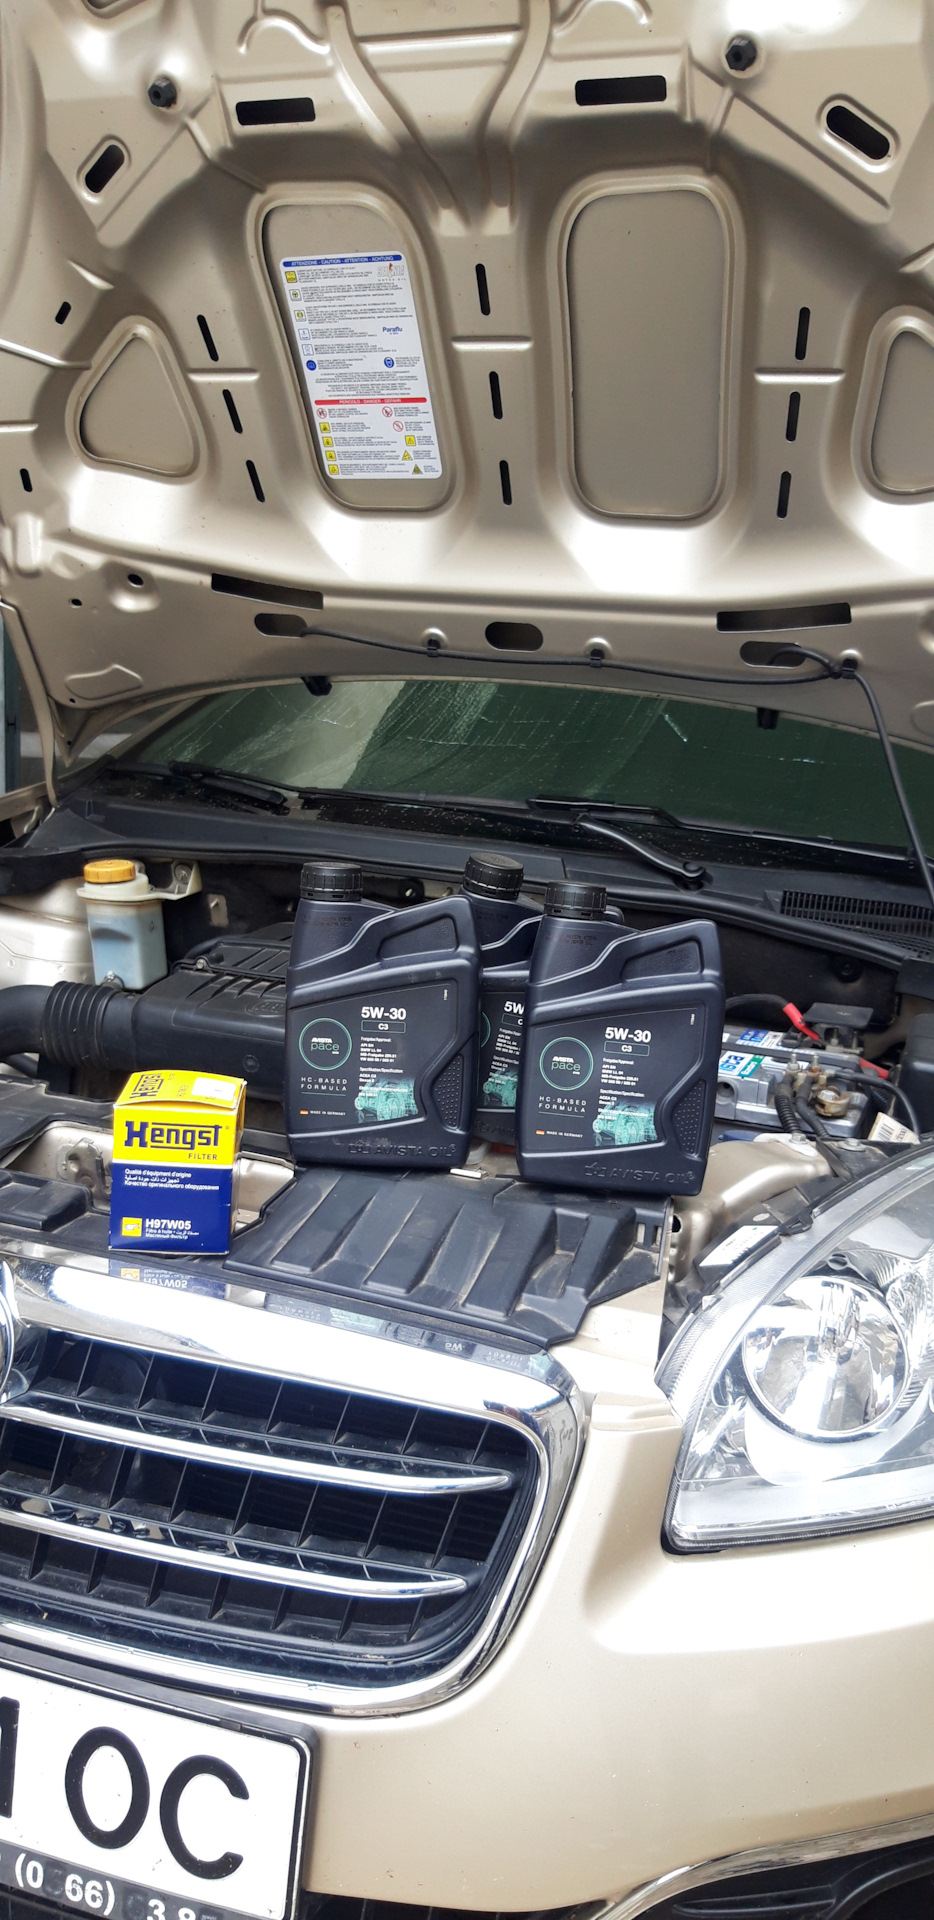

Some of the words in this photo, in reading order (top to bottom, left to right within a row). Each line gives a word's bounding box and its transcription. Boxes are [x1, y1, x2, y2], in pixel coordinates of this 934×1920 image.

[361, 1006, 406, 1020] 5W-30
[605, 1027, 651, 1043] 5W-30
[311, 1043, 340, 1051] pace
[551, 1062, 580, 1071] pace
[538, 1103, 585, 1112] FORMULA
[124, 1120, 222, 1150] Hengst
[146, 1218, 192, 1230] H97W05
[65, 1726, 250, 1880] OC
